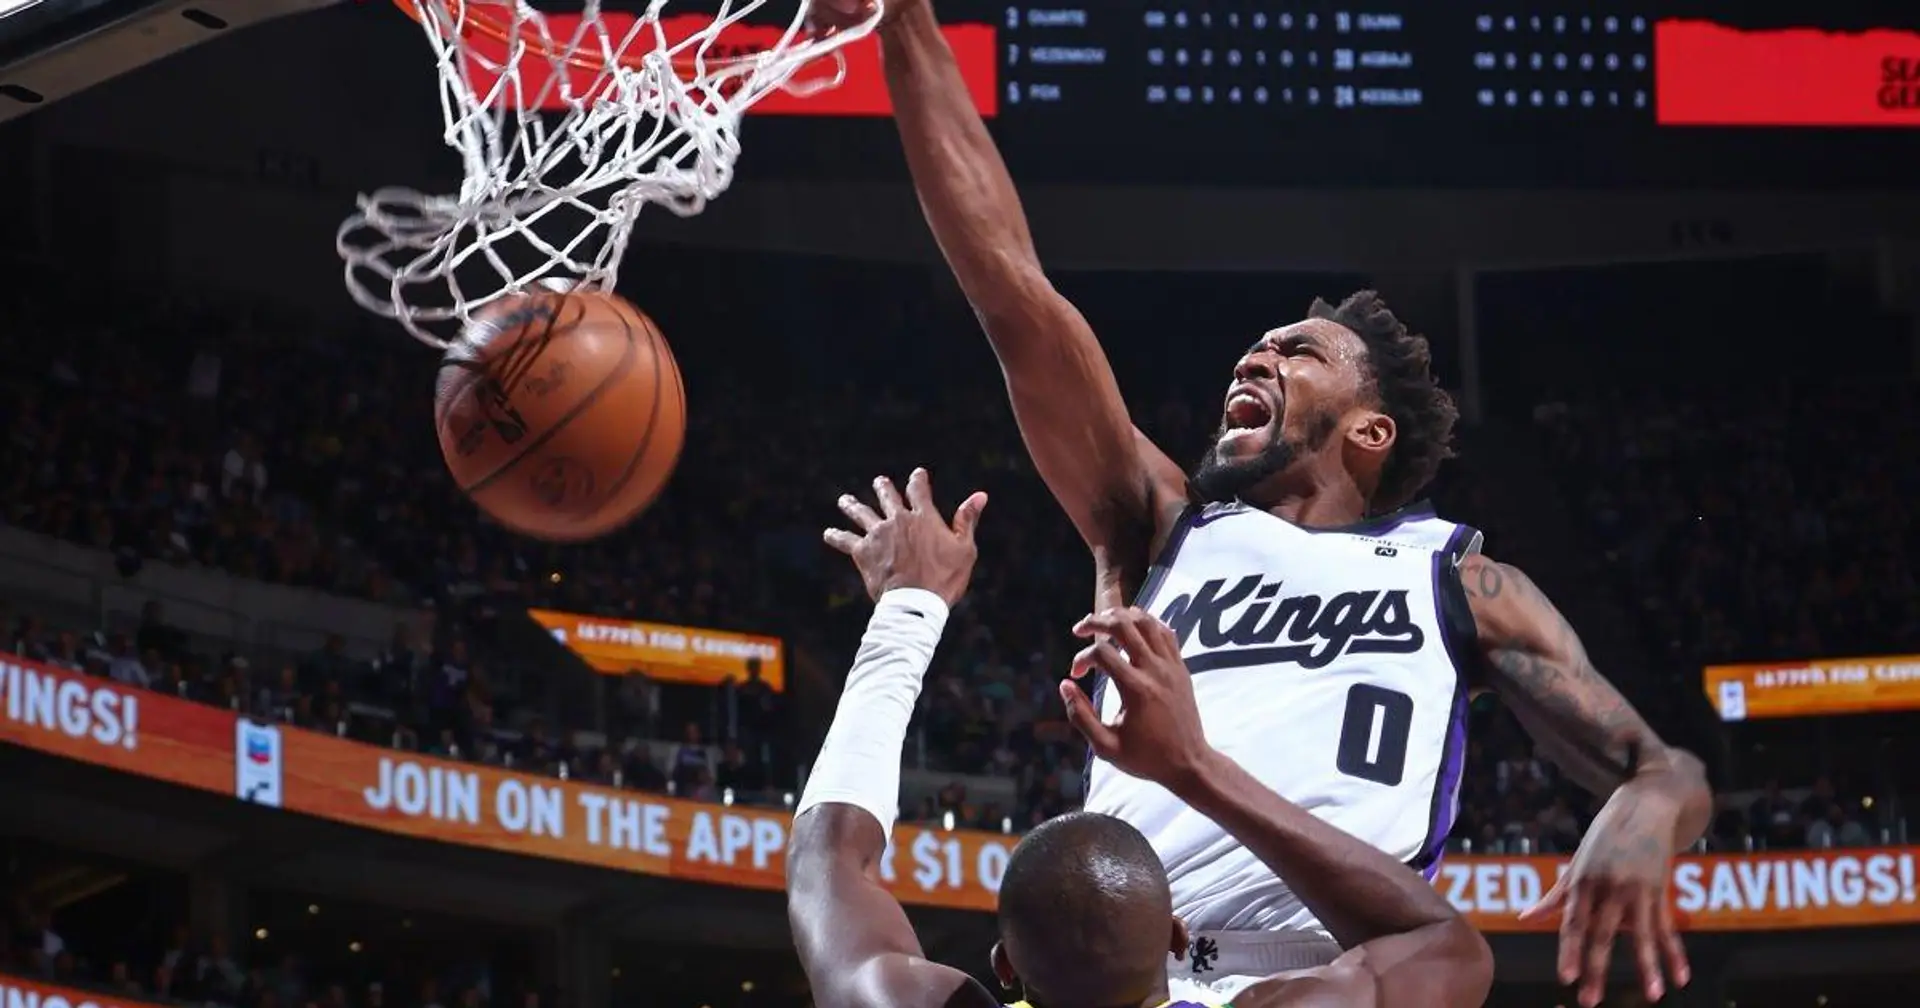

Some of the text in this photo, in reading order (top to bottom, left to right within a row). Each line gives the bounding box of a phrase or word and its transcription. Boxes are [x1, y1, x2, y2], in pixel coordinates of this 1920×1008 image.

[1160, 573, 1424, 670] Kings
[1336, 683, 1414, 787] 0
[363, 758, 481, 825] JOIN
[496, 778, 565, 838] ON
[577, 791, 672, 856] THE
[685, 811, 784, 868] APP
[911, 829, 963, 892] $1
[1673, 854, 1916, 912] SAVINGS!
